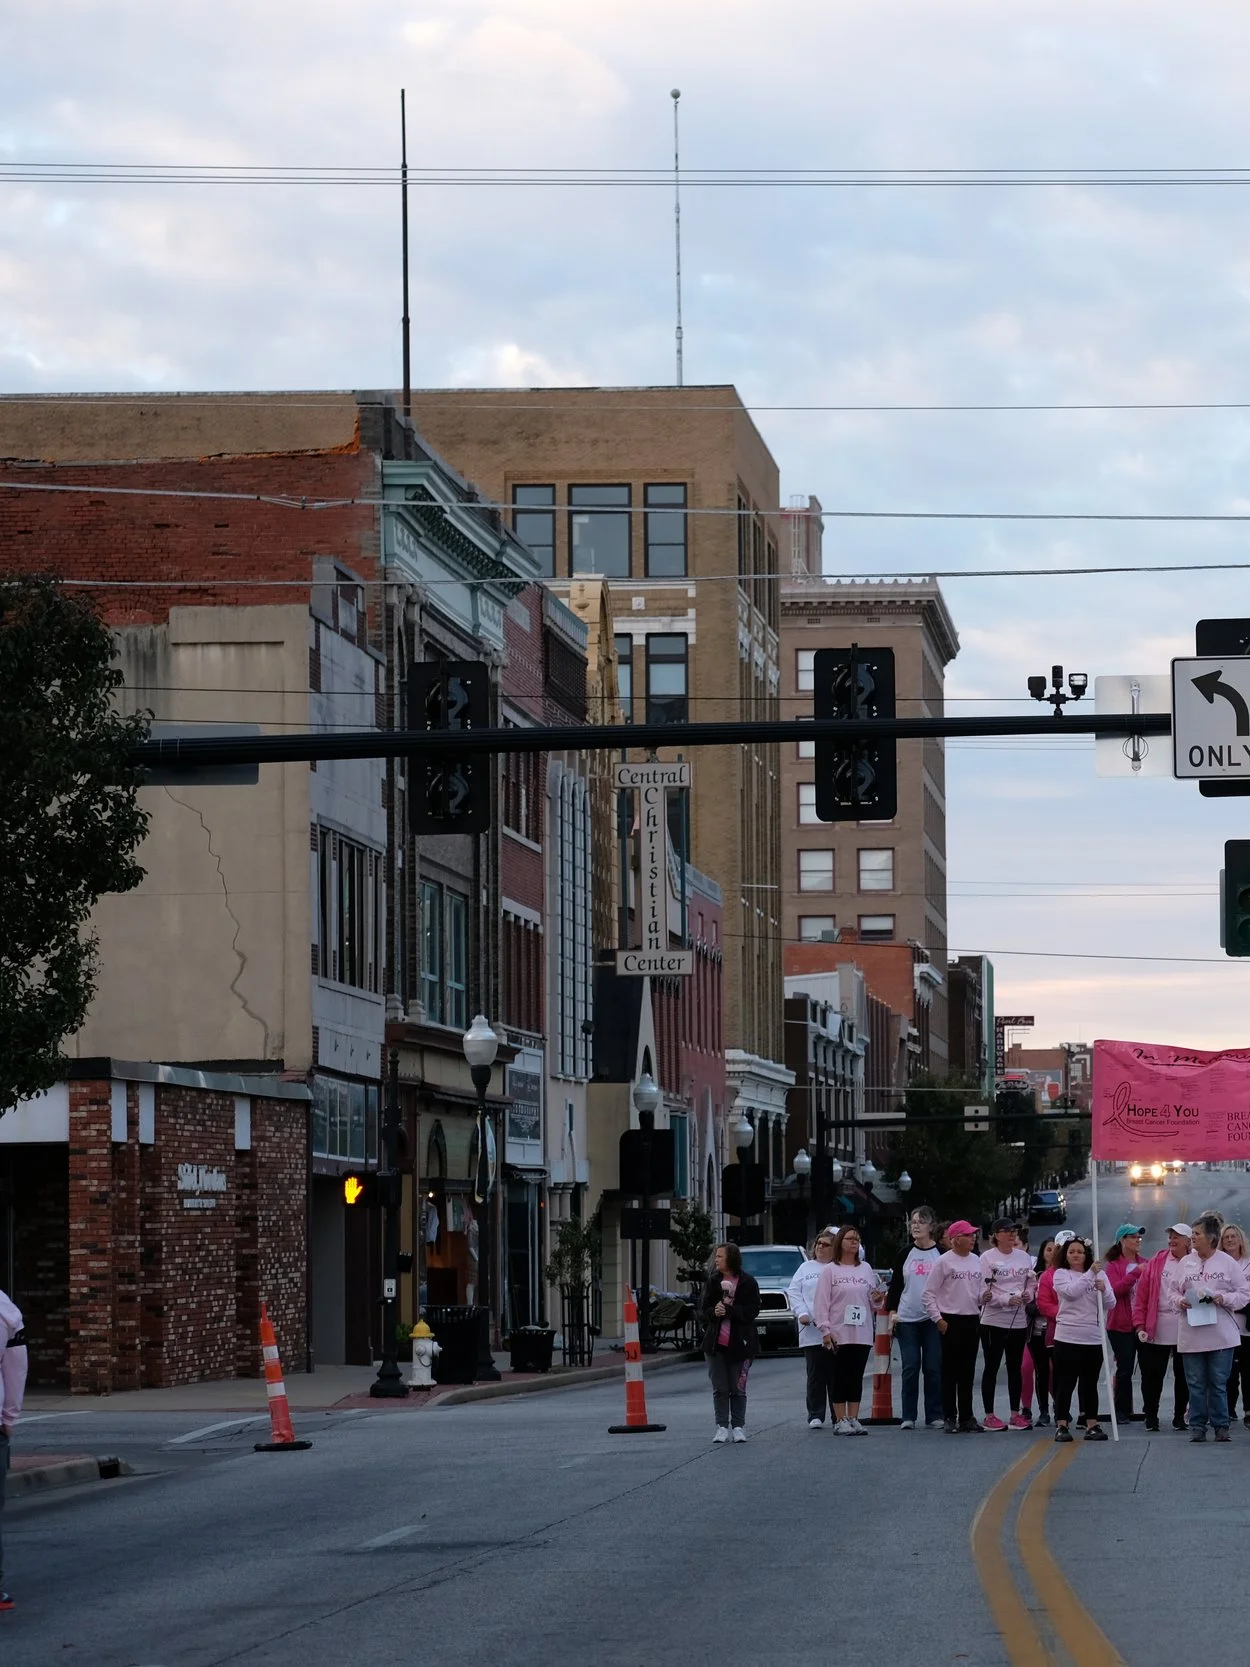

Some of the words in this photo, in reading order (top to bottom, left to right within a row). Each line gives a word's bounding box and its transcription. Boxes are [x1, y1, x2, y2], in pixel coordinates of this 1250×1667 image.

[617, 765, 686, 785] Central
[644, 786, 662, 950] Christian
[624, 954, 686, 972] Center
[1144, 1118, 1166, 1126] Cancer
[1166, 1118, 1200, 1126] Foundation
[851, 1312, 861, 1321] 34
